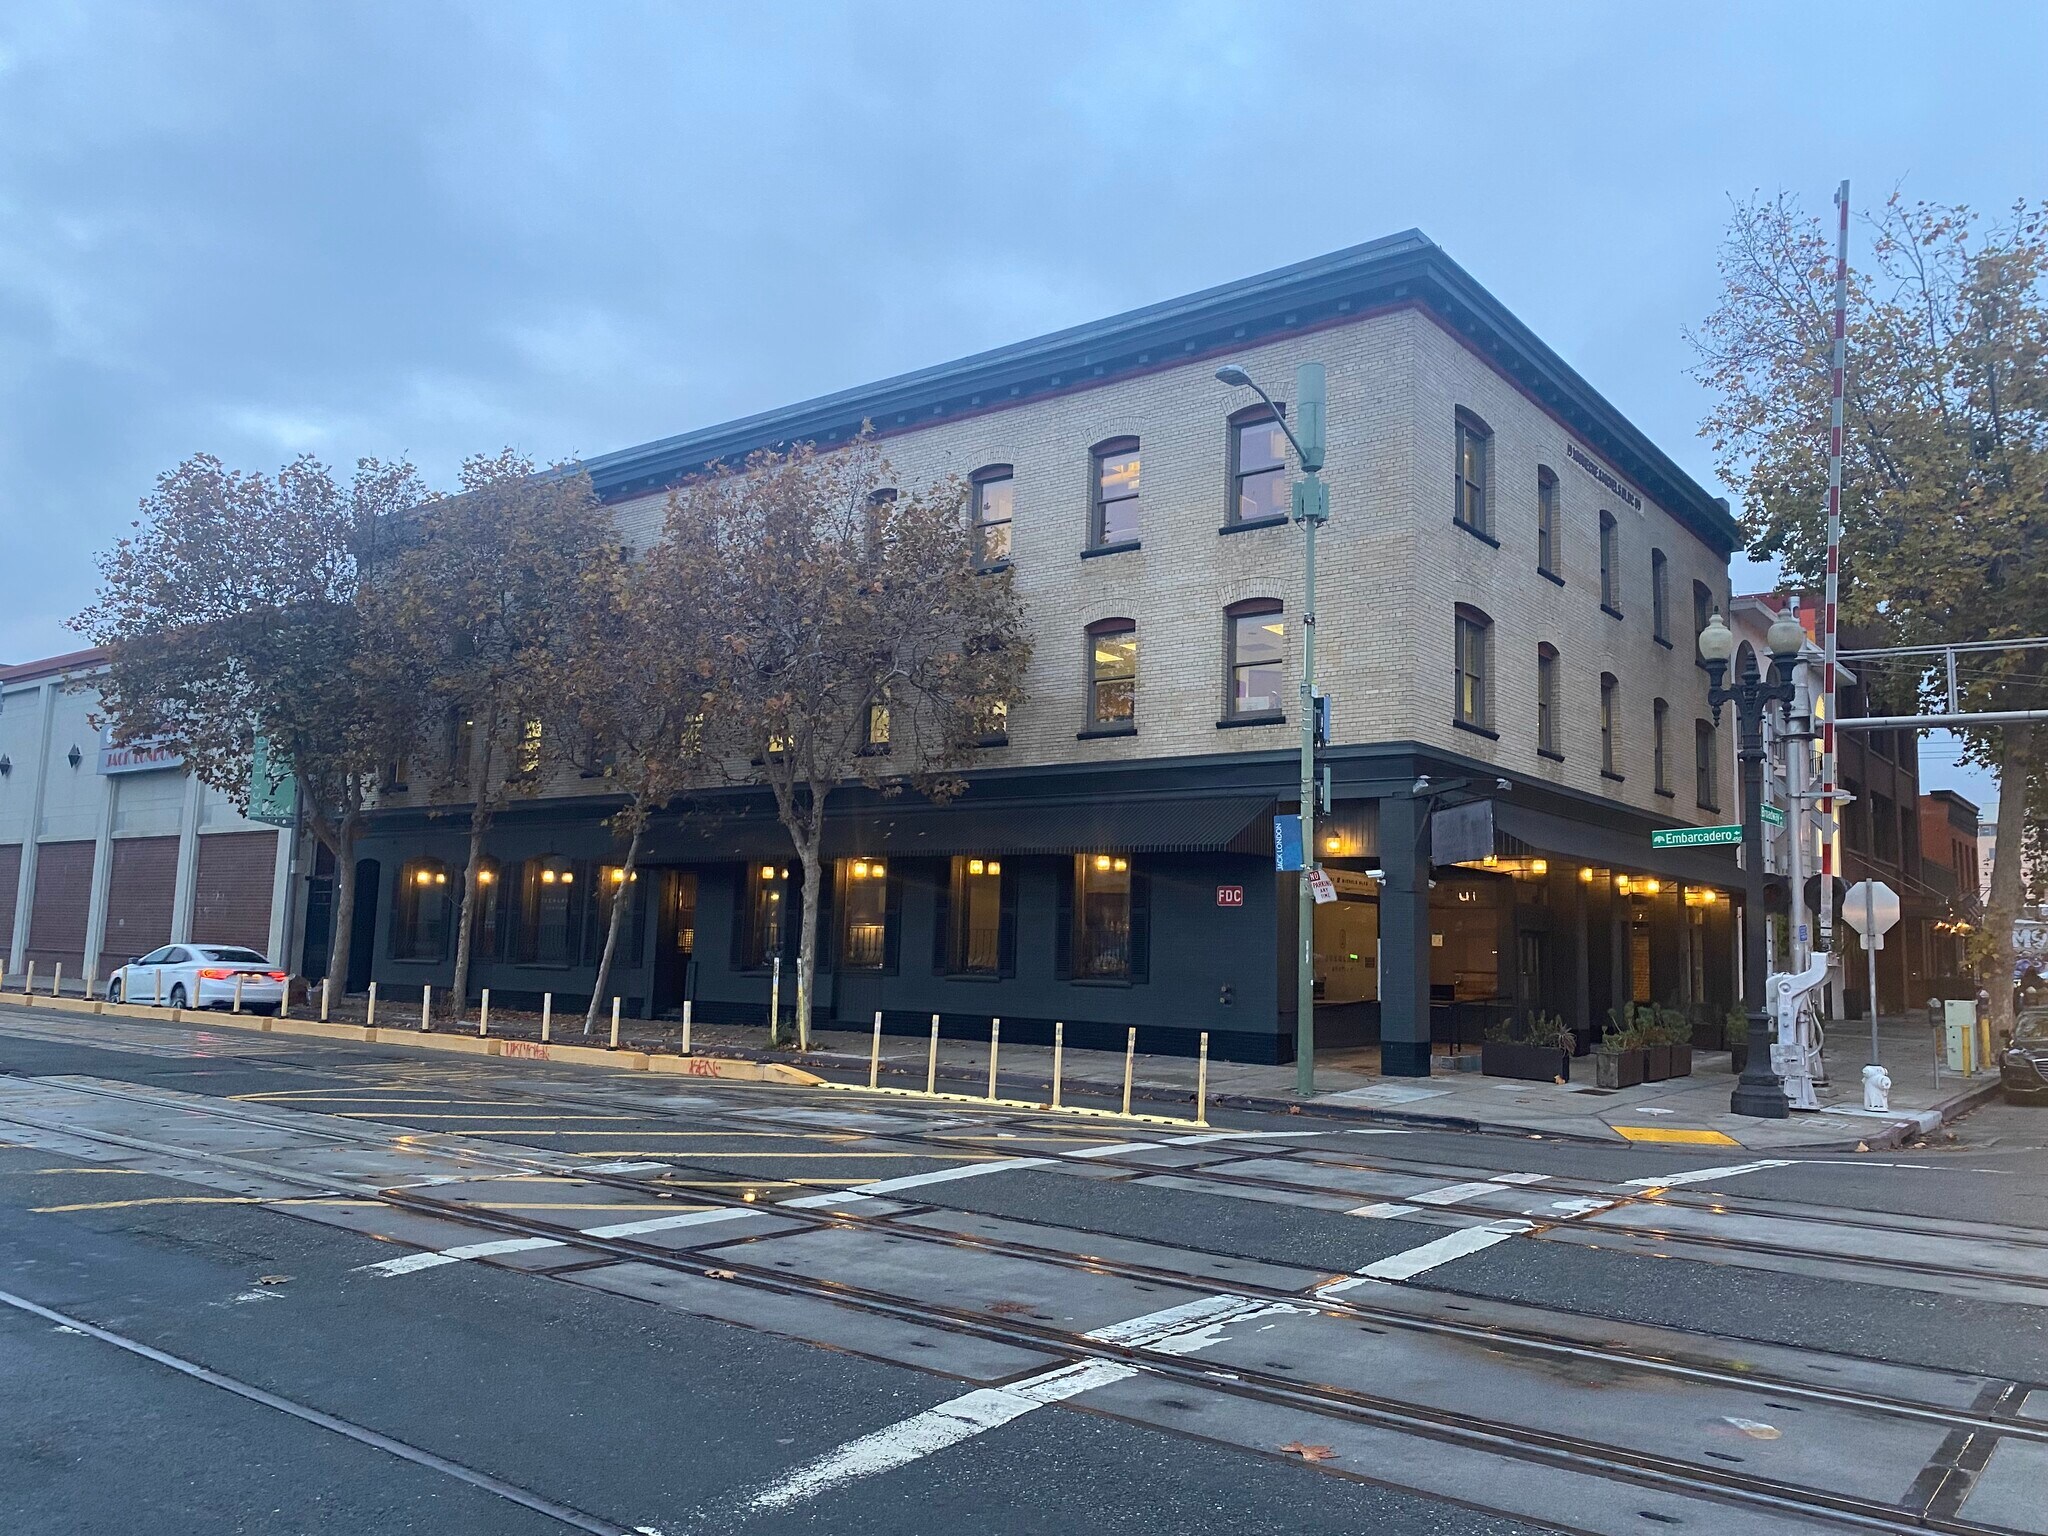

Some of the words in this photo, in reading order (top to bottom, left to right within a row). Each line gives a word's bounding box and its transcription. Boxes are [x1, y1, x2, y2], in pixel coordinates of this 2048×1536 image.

[106, 752, 129, 767] JACK
[251, 783, 261, 816] JACK
[1666, 831, 1732, 844] Embarcadero
[1310, 871, 1319, 880] NO
[1218, 889, 1241, 902] FDC
